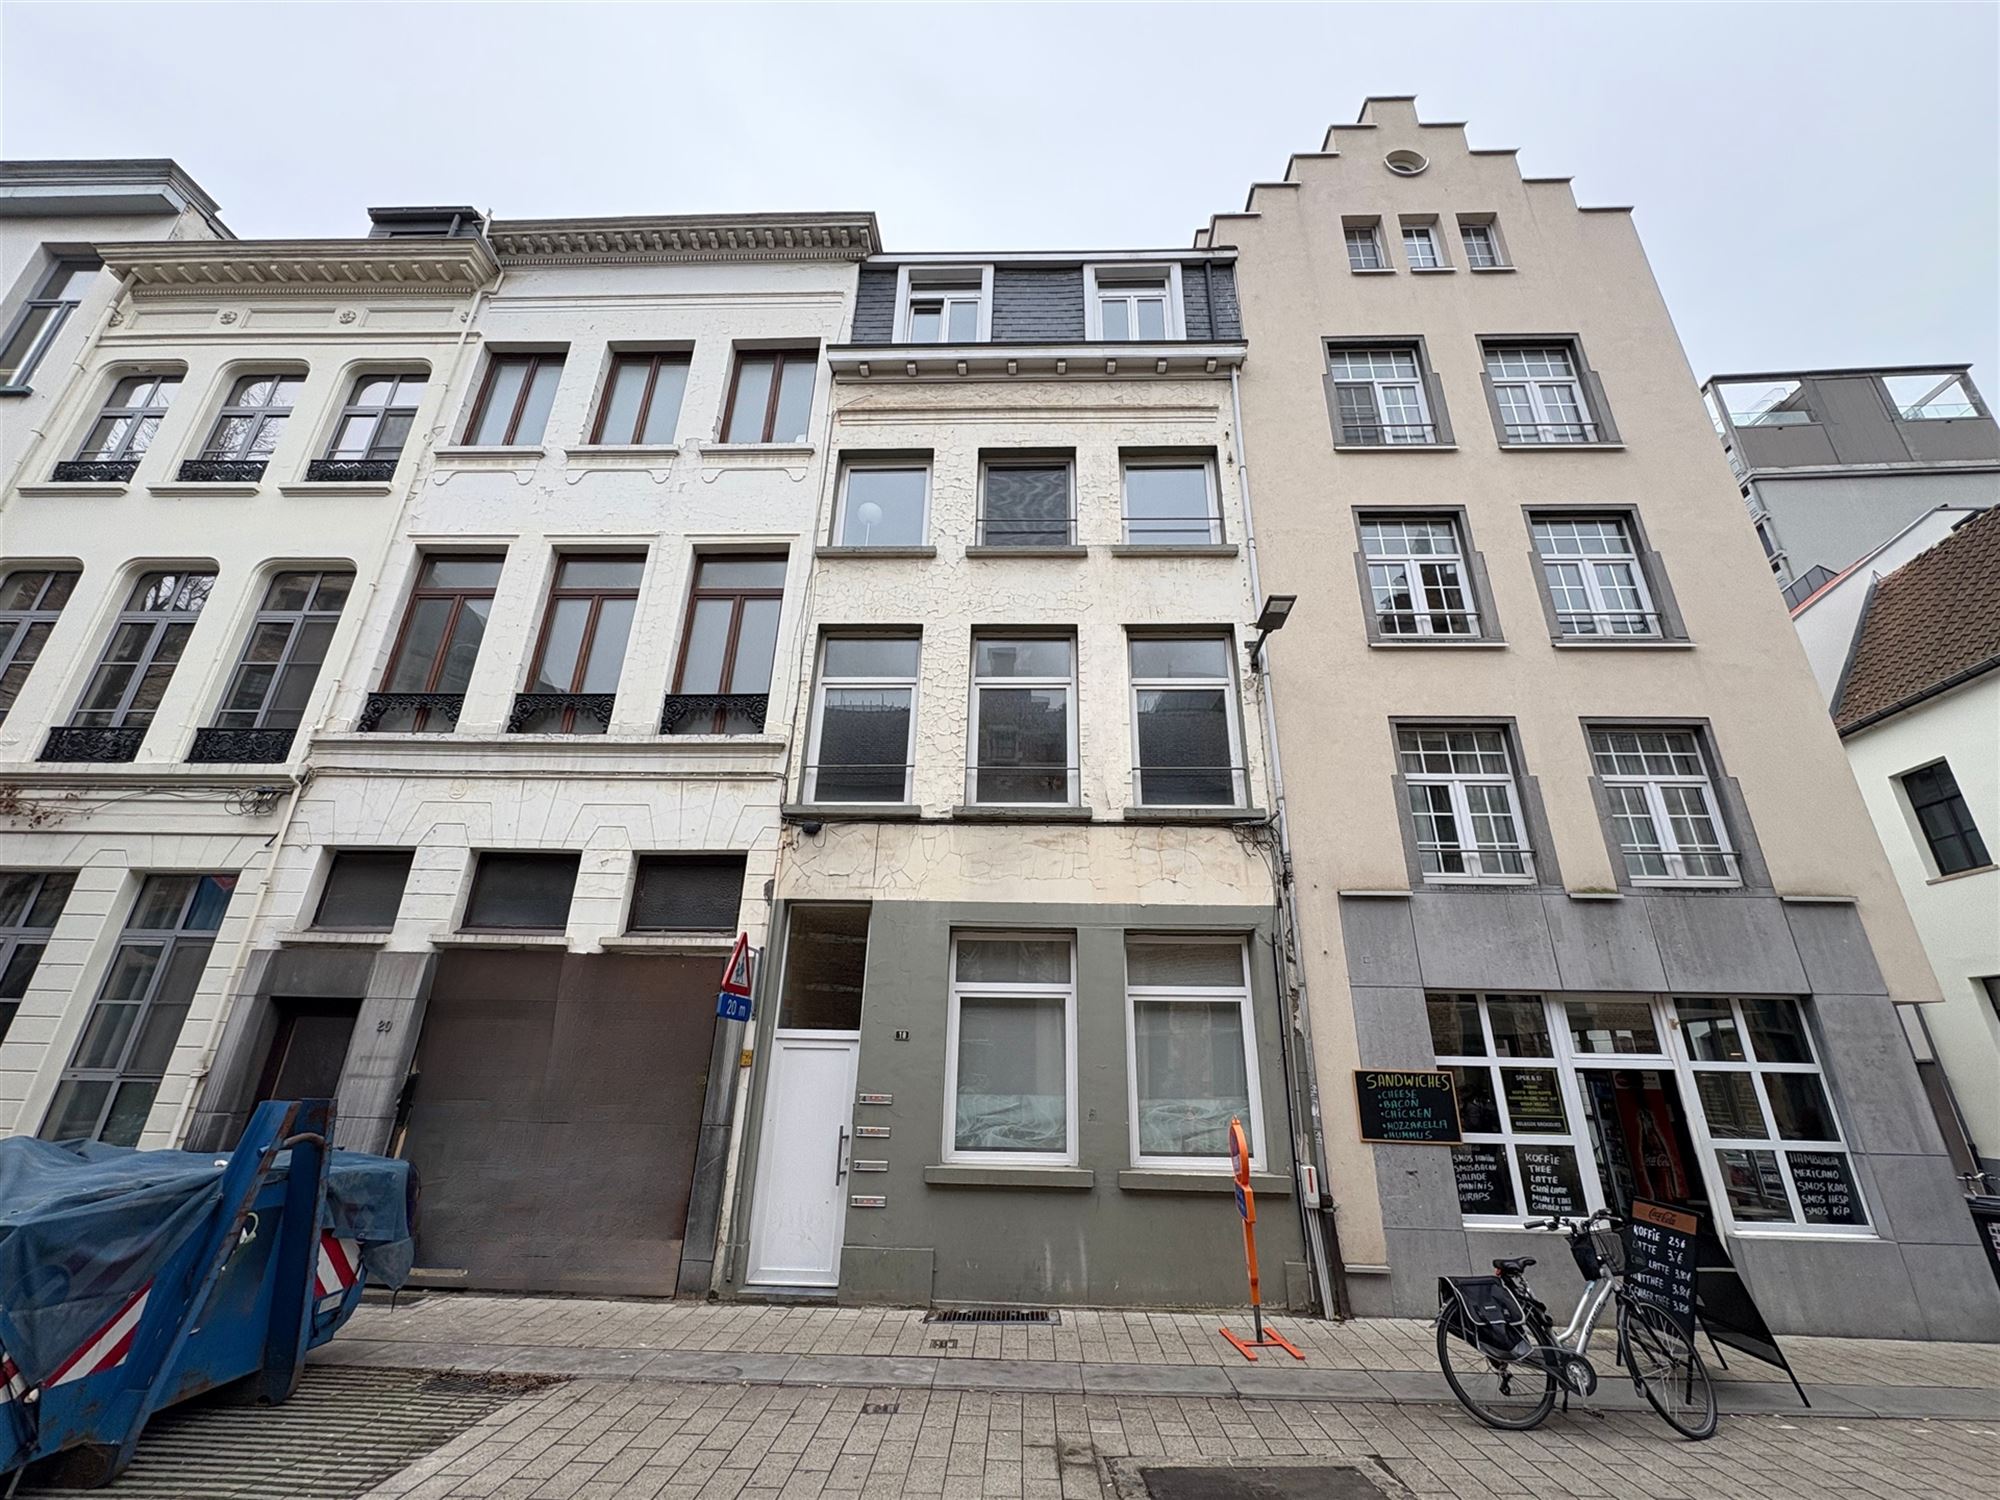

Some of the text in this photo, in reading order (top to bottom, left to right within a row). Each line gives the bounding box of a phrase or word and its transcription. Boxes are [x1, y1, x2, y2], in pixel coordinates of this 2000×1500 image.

[726, 999, 747, 1017] 20 m
[376, 1020, 393, 1033] 20
[1366, 1073, 1450, 1092] SANDWICHES
[1381, 1089, 1418, 1100] CHEESE
[1383, 1099, 1419, 1109] BACON
[1384, 1107, 1432, 1119] CHICKEN
[1525, 1153, 1560, 1165] KOFFIE
[1528, 1164, 1552, 1173] THEE
[1793, 1168, 1840, 1179] MEXICANO
[1456, 1172, 1487, 1182] SALADE
[1530, 1175, 1559, 1184] LATTE
[1459, 1181, 1494, 1191] PANINIS
[1797, 1181, 1826, 1192] SMOS
[1460, 1192, 1490, 1202] WRAPS
[1802, 1194, 1826, 1204] SMOS
[1805, 1205, 1850, 1216] SMOS KIP
[1633, 1224, 1661, 1242] KOFFIE
[1648, 1259, 1670, 1276] LATTE
